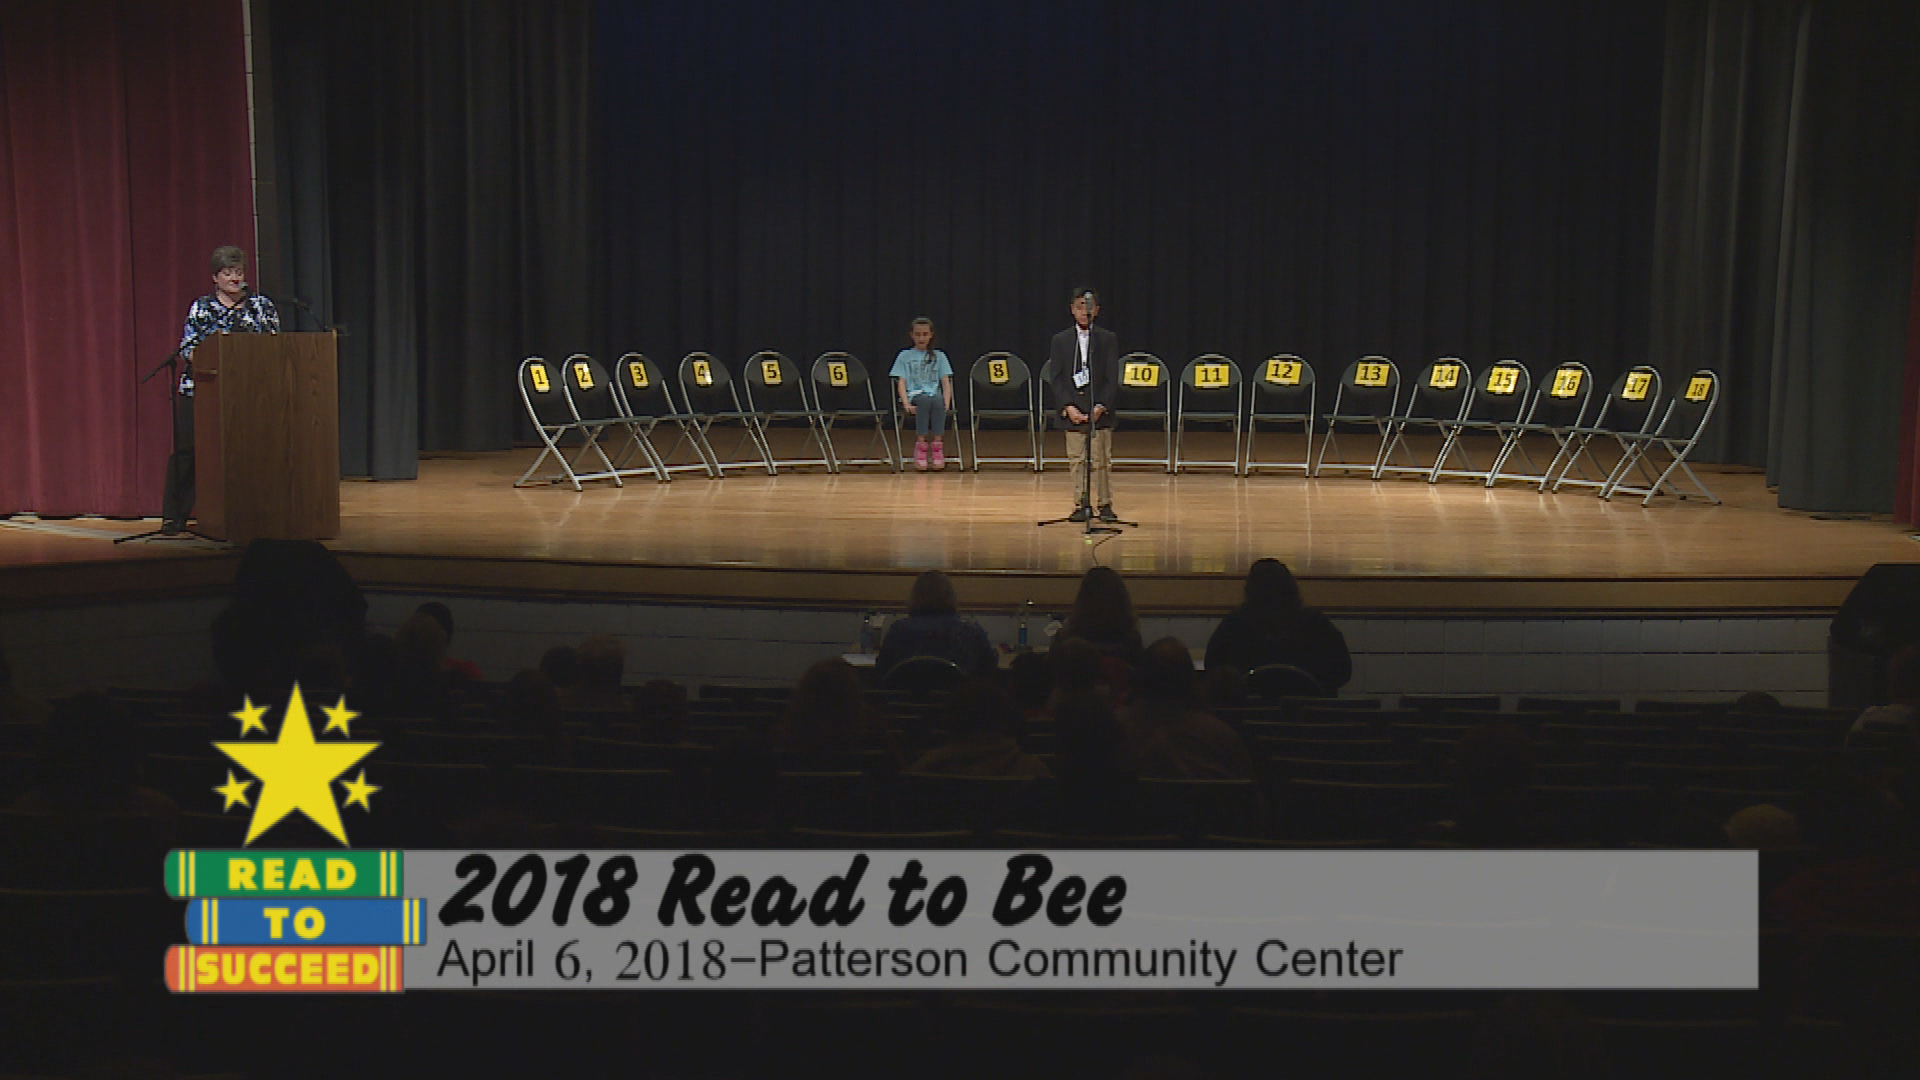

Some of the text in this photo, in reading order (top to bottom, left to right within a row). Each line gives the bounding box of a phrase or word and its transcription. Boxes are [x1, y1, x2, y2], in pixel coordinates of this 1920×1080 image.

[1131, 366, 1152, 381] 10
[1201, 367, 1222, 382] 11
[1270, 364, 1293, 379] 12
[1360, 365, 1381, 381] 13
[1434, 369, 1455, 383] 14
[1493, 371, 1513, 387] 15
[1557, 375, 1577, 390] 16
[1627, 377, 1648, 394] 17
[1691, 383, 1706, 397] 18
